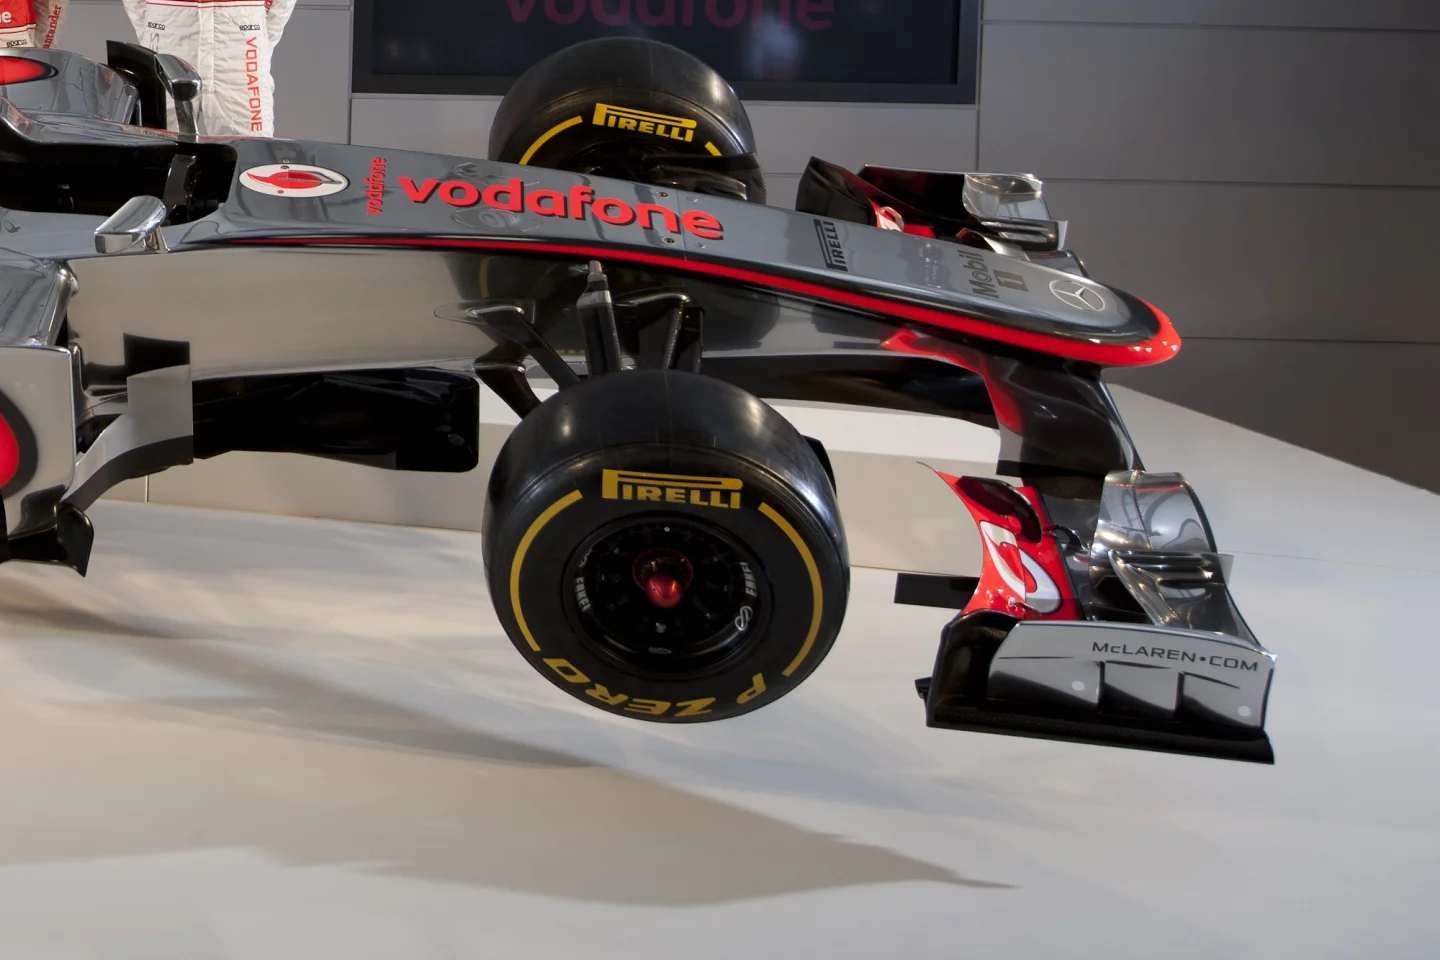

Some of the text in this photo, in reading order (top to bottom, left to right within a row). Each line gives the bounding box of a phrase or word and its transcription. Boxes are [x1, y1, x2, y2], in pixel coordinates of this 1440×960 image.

[245, 35, 263, 132] VODAFONE
[592, 102, 697, 142] PIRELLI
[366, 157, 387, 216] vodafone
[398, 176, 724, 240] vodafone
[813, 218, 849, 272] PIRELLI
[957, 249, 1000, 299] Mobil
[602, 468, 744, 510] PIRELLI
[542, 656, 769, 718] P ZERO
